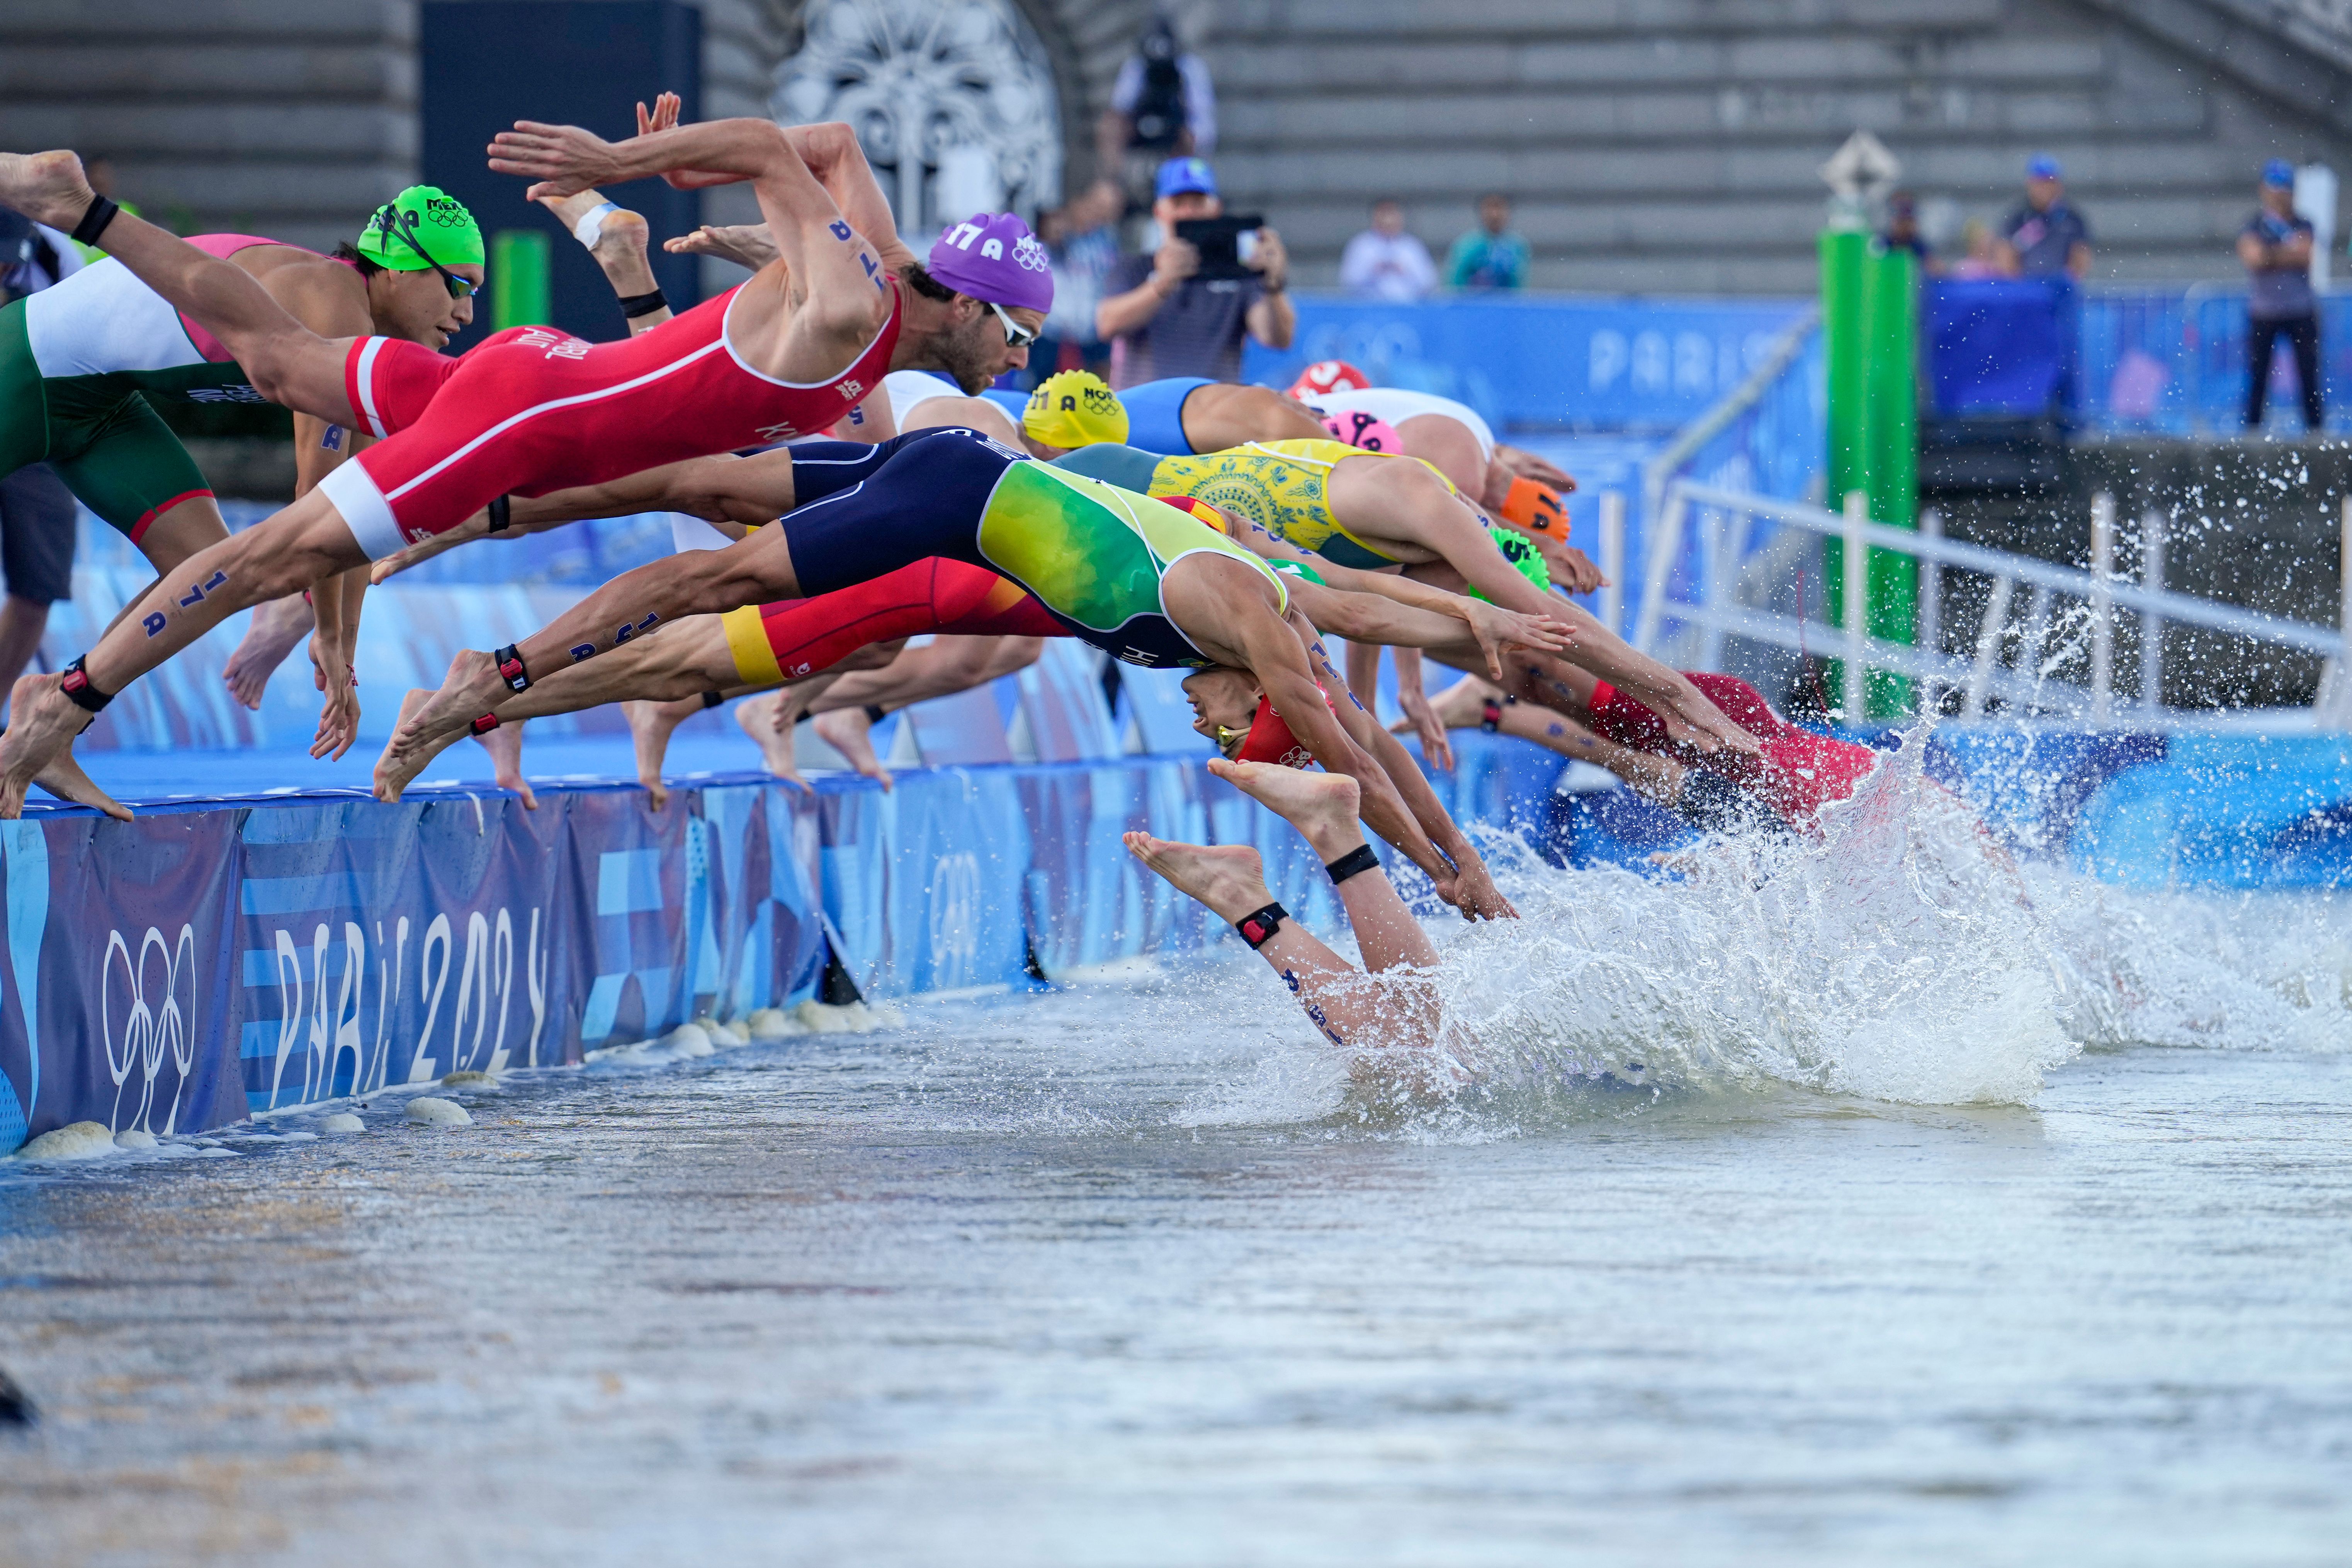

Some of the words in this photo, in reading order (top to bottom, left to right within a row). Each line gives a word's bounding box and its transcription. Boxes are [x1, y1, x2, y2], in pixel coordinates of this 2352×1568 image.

[403, 210, 419, 228] A
[945, 222, 984, 251] 17
[981, 238, 1003, 261] A
[1061, 395, 1075, 411] A
[321, 423, 344, 452] A
[180, 569, 228, 608] 17
[142, 610, 167, 639] A
[569, 642, 597, 663] A
[408, 907, 548, 1082] 2024
